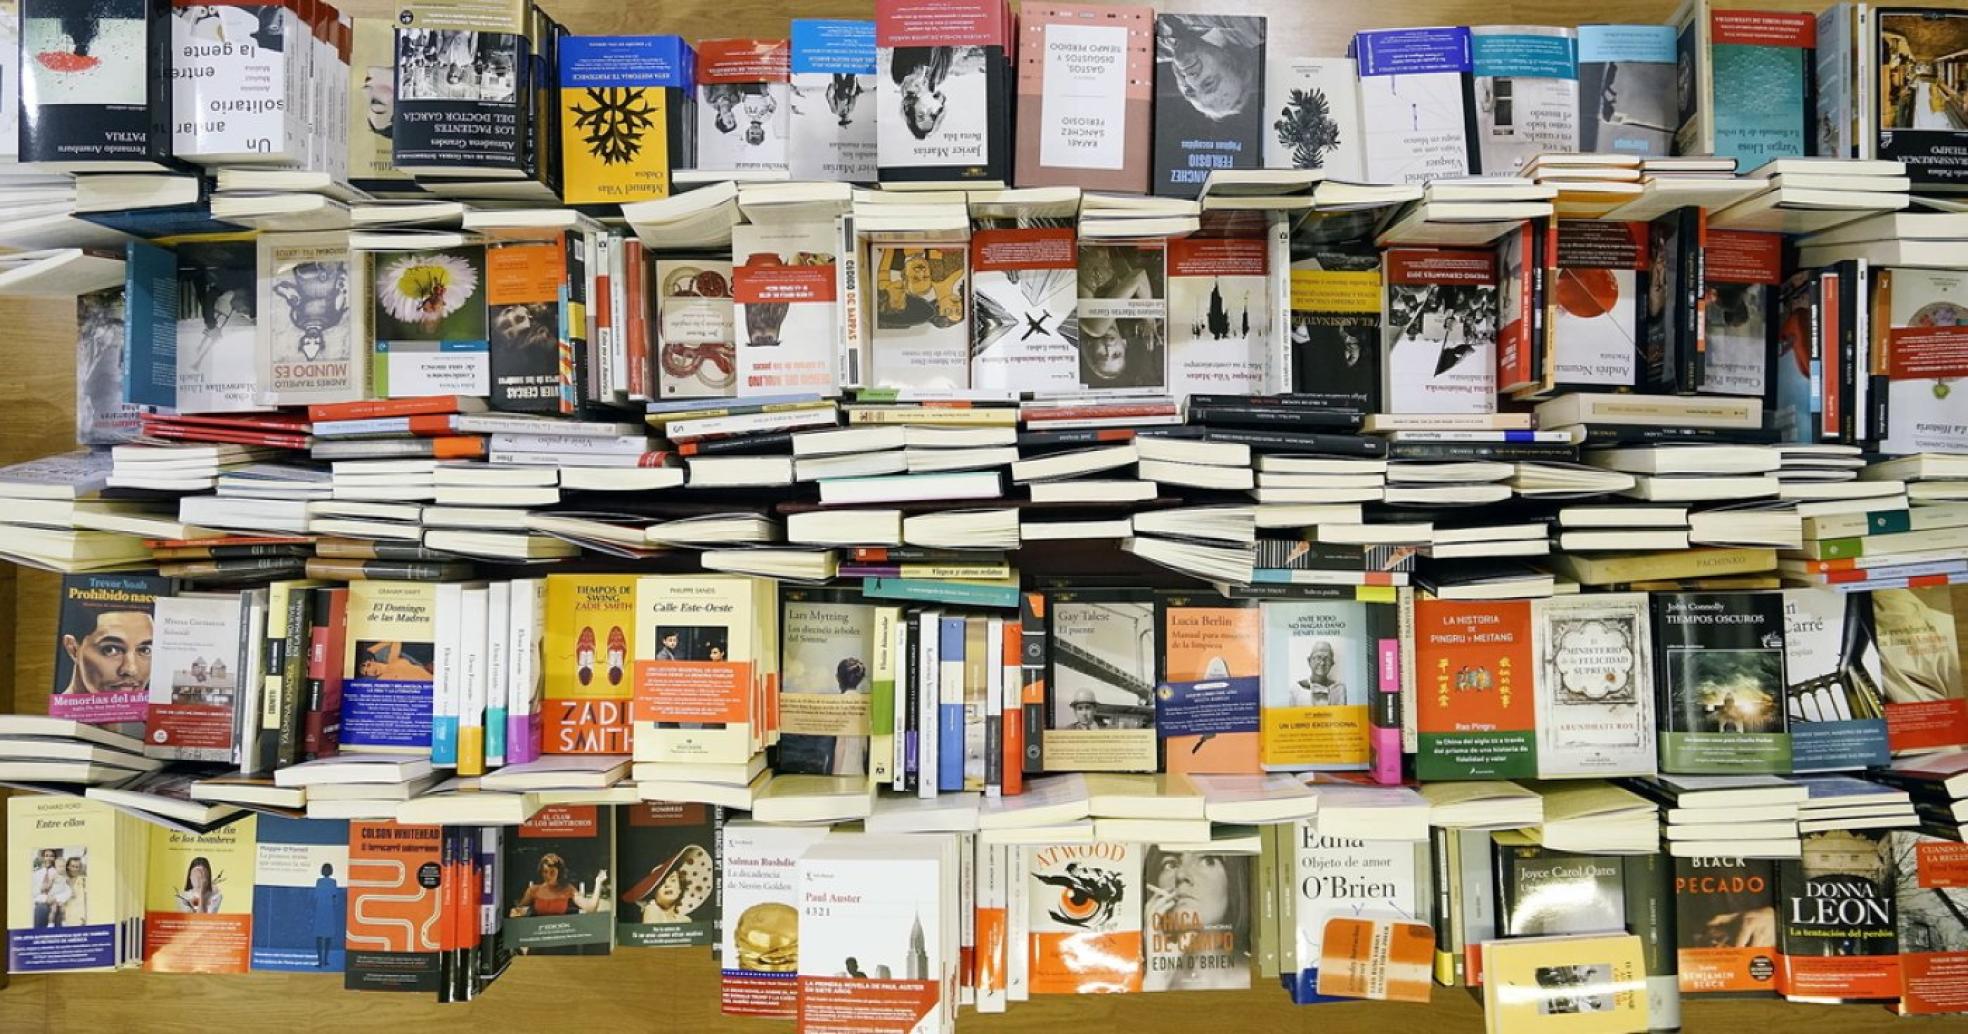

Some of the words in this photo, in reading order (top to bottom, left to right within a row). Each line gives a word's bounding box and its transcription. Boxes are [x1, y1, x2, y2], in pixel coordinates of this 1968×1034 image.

[183, 42, 233, 58] gente
[240, 45, 255, 58] la
[1049, 42, 1088, 52] PERDIDO
[1090, 43, 1122, 52] TIEMPO
[1064, 54, 1115, 64] DISGUSTOS
[171, 66, 216, 80] entre
[210, 99, 285, 113] solitario
[402, 111, 442, 122] GARCÍA
[444, 111, 492, 122] DOCTOR
[494, 112, 516, 123] DEL
[1061, 116, 1106, 126] FERLOSIO
[1530, 110, 1562, 121] mundo
[433, 123, 492, 134] PACIENTES
[495, 125, 516, 136] LOS
[105, 131, 147, 142] PATRIA
[943, 132, 957, 142] Isla
[960, 132, 982, 142] Berta
[1402, 137, 1430, 146] blanco
[246, 139, 271, 153] Un
[430, 138, 468, 148] Grandes
[469, 139, 516, 149] Almudena
[1066, 138, 1098, 148] RAFAEL
[1737, 142, 1765, 154] Llosa
[1767, 142, 1800, 154] Vargas
[57, 144, 102, 154] Aramburu
[104, 144, 147, 155] Fernando
[913, 146, 950, 157] Marías
[952, 144, 982, 157] Javier
[1188, 154, 1234, 168] FERLOSIO
[1404, 172, 1440, 184] Gabriel
[598, 184, 623, 195] Vilas
[624, 183, 664, 195] Manuel
[1423, 271, 1464, 280] CERVANTES
[1599, 352, 1631, 362] Fractura
[274, 365, 290, 377] ES
[293, 363, 347, 377] MUNDO
[1595, 365, 1631, 378] Andrés
[317, 378, 348, 388] ANDRÉS
[1185, 372, 1230, 383] Vila-Matas
[1230, 372, 1263, 383] Enrique
[274, 380, 316, 389] TRAPIELLO
[1473, 384, 1494, 395] Elena
[505, 386, 538, 398] CERCAS
[1916, 423, 1952, 435] Historia
[1696, 554, 1747, 568] PACHINKO
[68, 587, 130, 602] Prohibido
[577, 585, 617, 595] TIEMPOS
[619, 585, 631, 594] DE
[372, 602, 384, 613] El
[385, 602, 427, 614] Domingo
[575, 602, 601, 611] ZADIE
[603, 602, 633, 611] SMITH
[652, 602, 677, 613] Calle
[679, 602, 735, 613] Este-Oeste
[1666, 601, 1687, 613] John
[1687, 602, 1725, 613] Connolly
[366, 612, 380, 623] de
[381, 613, 398, 623] las
[399, 613, 431, 624] Madres
[788, 608, 809, 621] Lars
[809, 609, 850, 623] Mytting
[1057, 611, 1081, 624] Gay
[1081, 610, 1110, 622] Talese
[1171, 615, 1198, 627] Lucía
[1201, 615, 1232, 627] Berlin
[1297, 615, 1315, 623] ANTE
[1315, 614, 1337, 623] TODO
[1443, 615, 1456, 626] LA
[1457, 615, 1500, 625] HISTORIA
[1665, 614, 1713, 625] TIEMPOS
[1714, 614, 1765, 625] OSCUROS
[1784, 615, 1824, 633] Carré
[1067, 626, 1095, 637] puente
[1171, 630, 1200, 640] Manual
[1201, 632, 1219, 642] para
[1429, 633, 1466, 644] PINGRU
[1473, 632, 1514, 643] MEITANG
[1578, 656, 1629, 665] FELICIDAD
[1573, 666, 1616, 675] SUPREMA
[53, 694, 109, 707] Memorias
[110, 692, 130, 704] del
[1278, 722, 1290, 730] UN
[1290, 722, 1311, 730] LIBRO
[1311, 721, 1358, 730] EXCEPCIONAL
[1455, 722, 1471, 731] Rao
[1471, 721, 1497, 732] Pingru
[1616, 723, 1634, 731] ROY
[560, 727, 634, 752] SMITH
[1443, 737, 1463, 746] China
[1474, 737, 1491, 747] siglo
[1444, 746, 1470, 756] prisma
[1495, 746, 1520, 755] historia
[1455, 754, 1485, 763] fidelidad
[36, 818, 62, 830] Entre
[63, 817, 86, 829] ellos
[549, 819, 593, 828] MENTIROSOS
[169, 833, 180, 843] de
[181, 834, 196, 844] los
[197, 834, 237, 845] hombres
[361, 827, 392, 840] COLSON
[394, 827, 440, 840] WHITEHEAD
[1036, 842, 1128, 869] ATWOOD
[727, 857, 760, 867] Salman
[761, 857, 796, 868] Rushdie
[1301, 856, 1343, 872] Objeto
[1344, 856, 1360, 868] de
[1362, 858, 1392, 869] amor
[738, 869, 781, 879] decadencia
[1520, 866, 1550, 882] Joyce
[1551, 866, 1584, 879] Carol
[1584, 865, 1618, 878] Oates
[762, 881, 792, 891] Golden
[1301, 875, 1397, 900] O'Brien
[1676, 876, 1765, 894] PECADO
[1805, 881, 1875, 900] DONNA
[805, 892, 828, 904] Paul
[829, 893, 863, 904] Auster
[806, 906, 832, 918] 4321
[1789, 897, 1891, 926] LEON
[1151, 911, 1201, 931] CHICA
[1789, 928, 1802, 938] La
[1802, 928, 1847, 939] tentación
[1847, 929, 1862, 939] del
[1862, 928, 1895, 941] perdón
[1151, 932, 1171, 953] DE
[1152, 956, 1184, 972] EDNA
[1186, 954, 1236, 970] O'BRIEN
[1683, 970, 1735, 981] BENJAMIN
